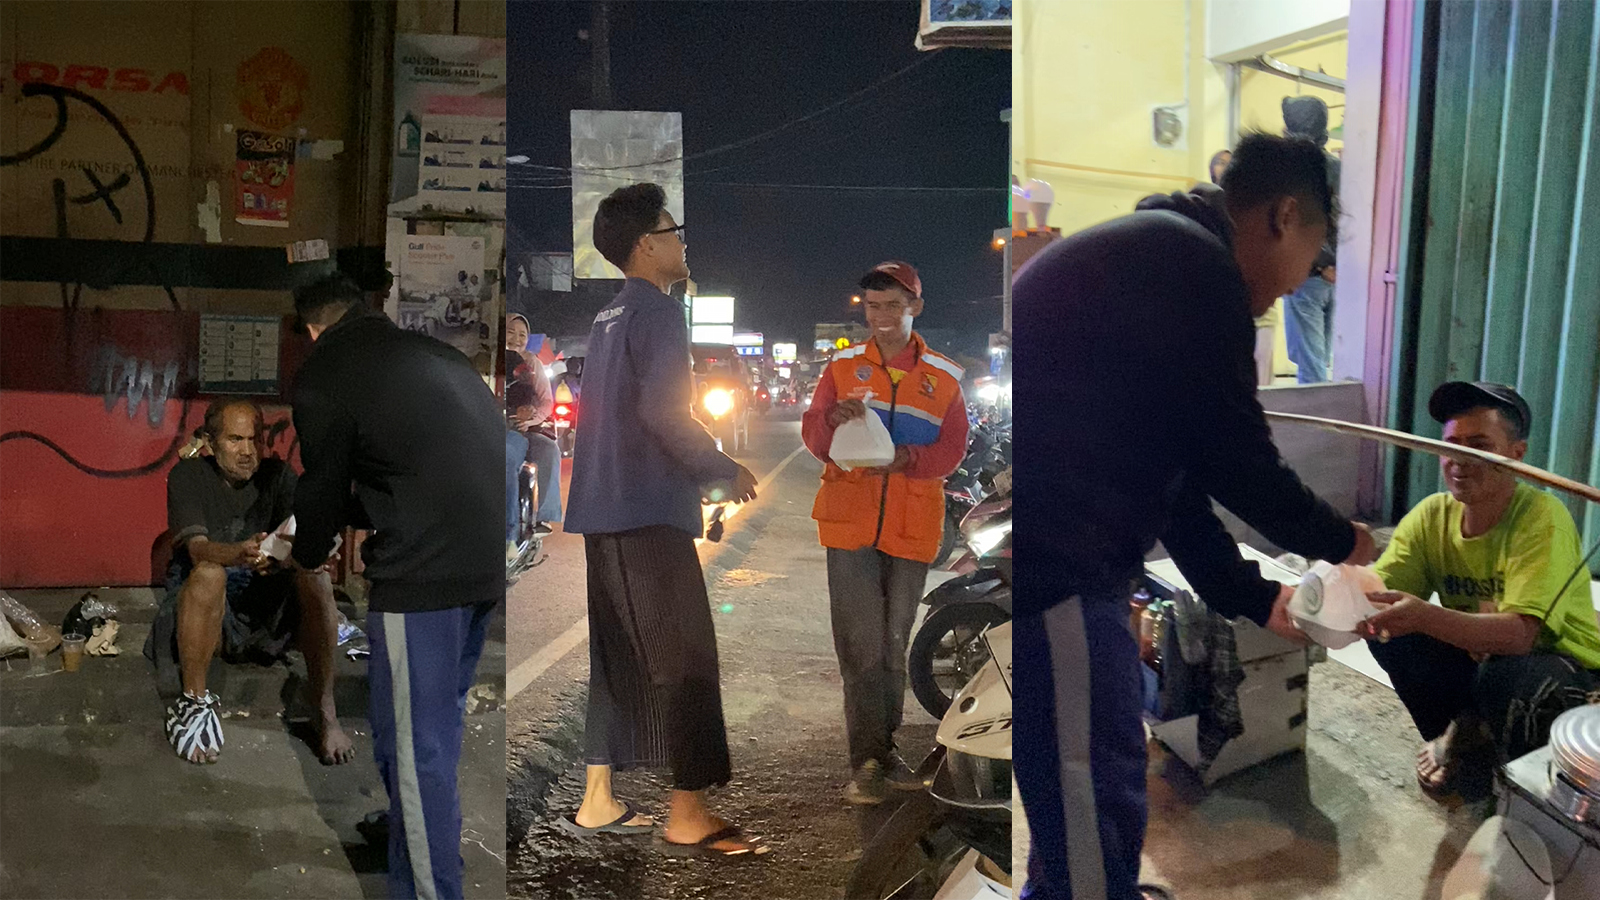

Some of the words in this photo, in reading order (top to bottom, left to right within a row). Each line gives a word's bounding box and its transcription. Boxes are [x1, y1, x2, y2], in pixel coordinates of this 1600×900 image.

[0, 61, 190, 96] ORSA
[60, 158, 120, 173] PARTNER
[408, 242, 424, 250] Gulf
